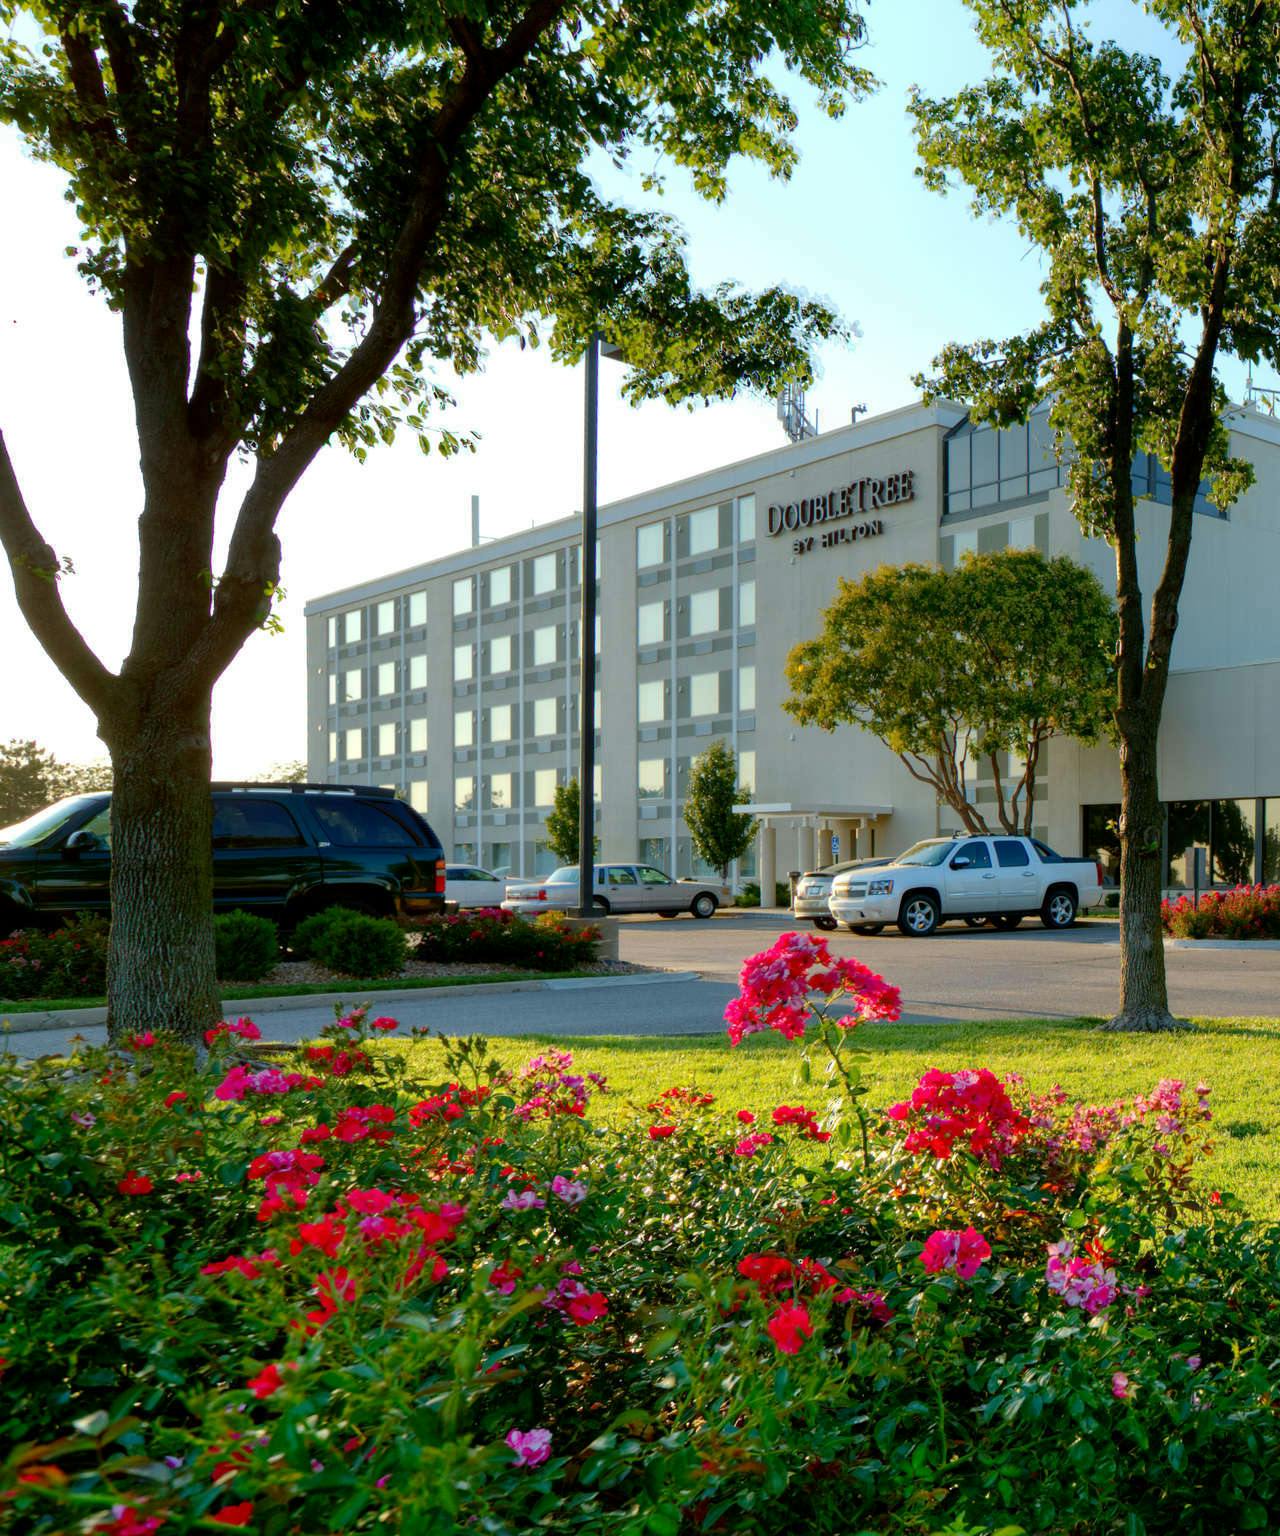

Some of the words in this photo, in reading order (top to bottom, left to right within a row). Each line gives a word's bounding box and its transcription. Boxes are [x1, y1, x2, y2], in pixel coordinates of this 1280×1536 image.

[767, 470, 915, 536] DOUBLETREE
[793, 537, 815, 554] BY
[822, 519, 884, 549] HILTON
